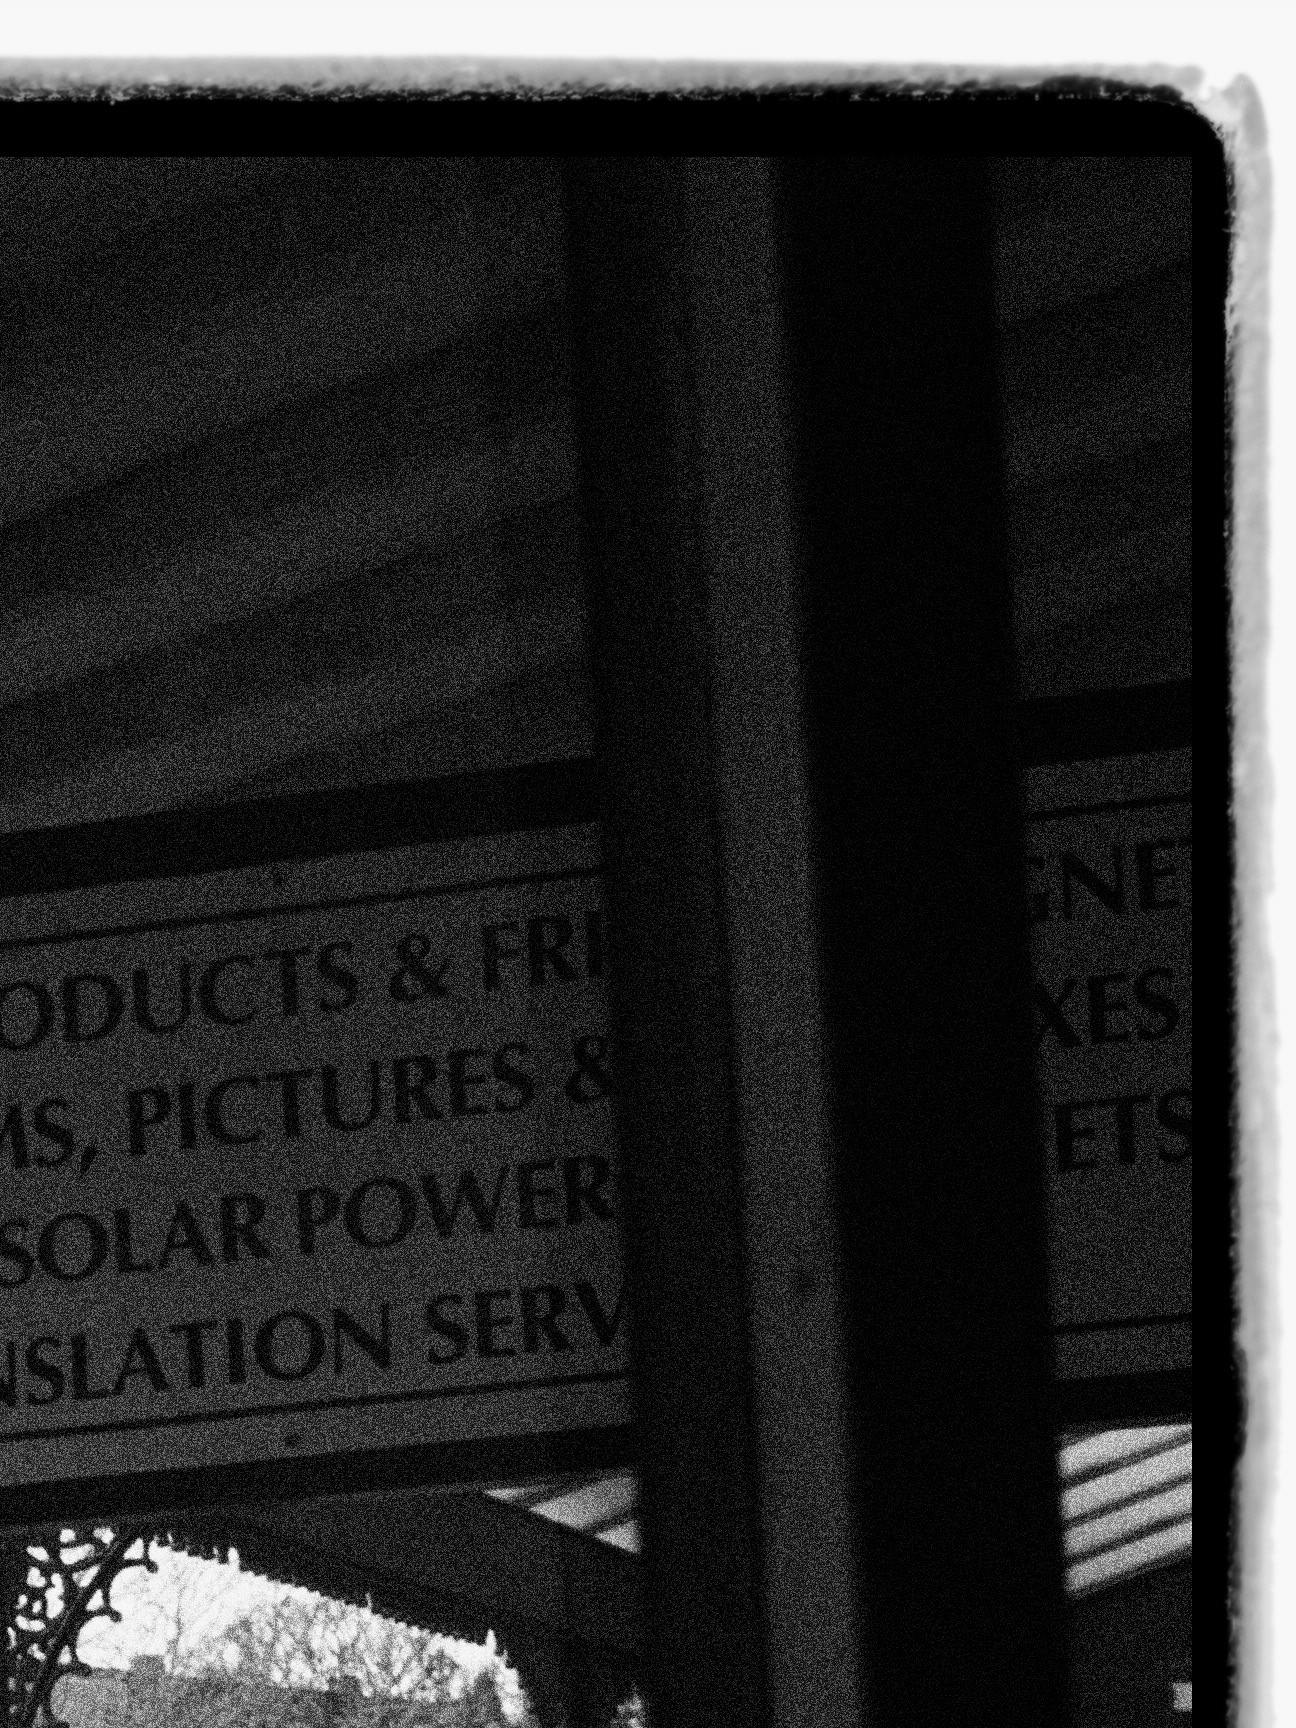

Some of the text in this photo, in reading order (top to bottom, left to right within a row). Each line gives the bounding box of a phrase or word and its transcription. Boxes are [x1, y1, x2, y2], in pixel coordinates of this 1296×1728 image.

[388, 932, 451, 1004] &
[479, 909, 605, 991] FRI
[125, 1041, 535, 1158] PICTURES
[563, 1034, 612, 1103] &
[295, 1153, 615, 1256] POWER
[423, 1280, 628, 1367] SERV
